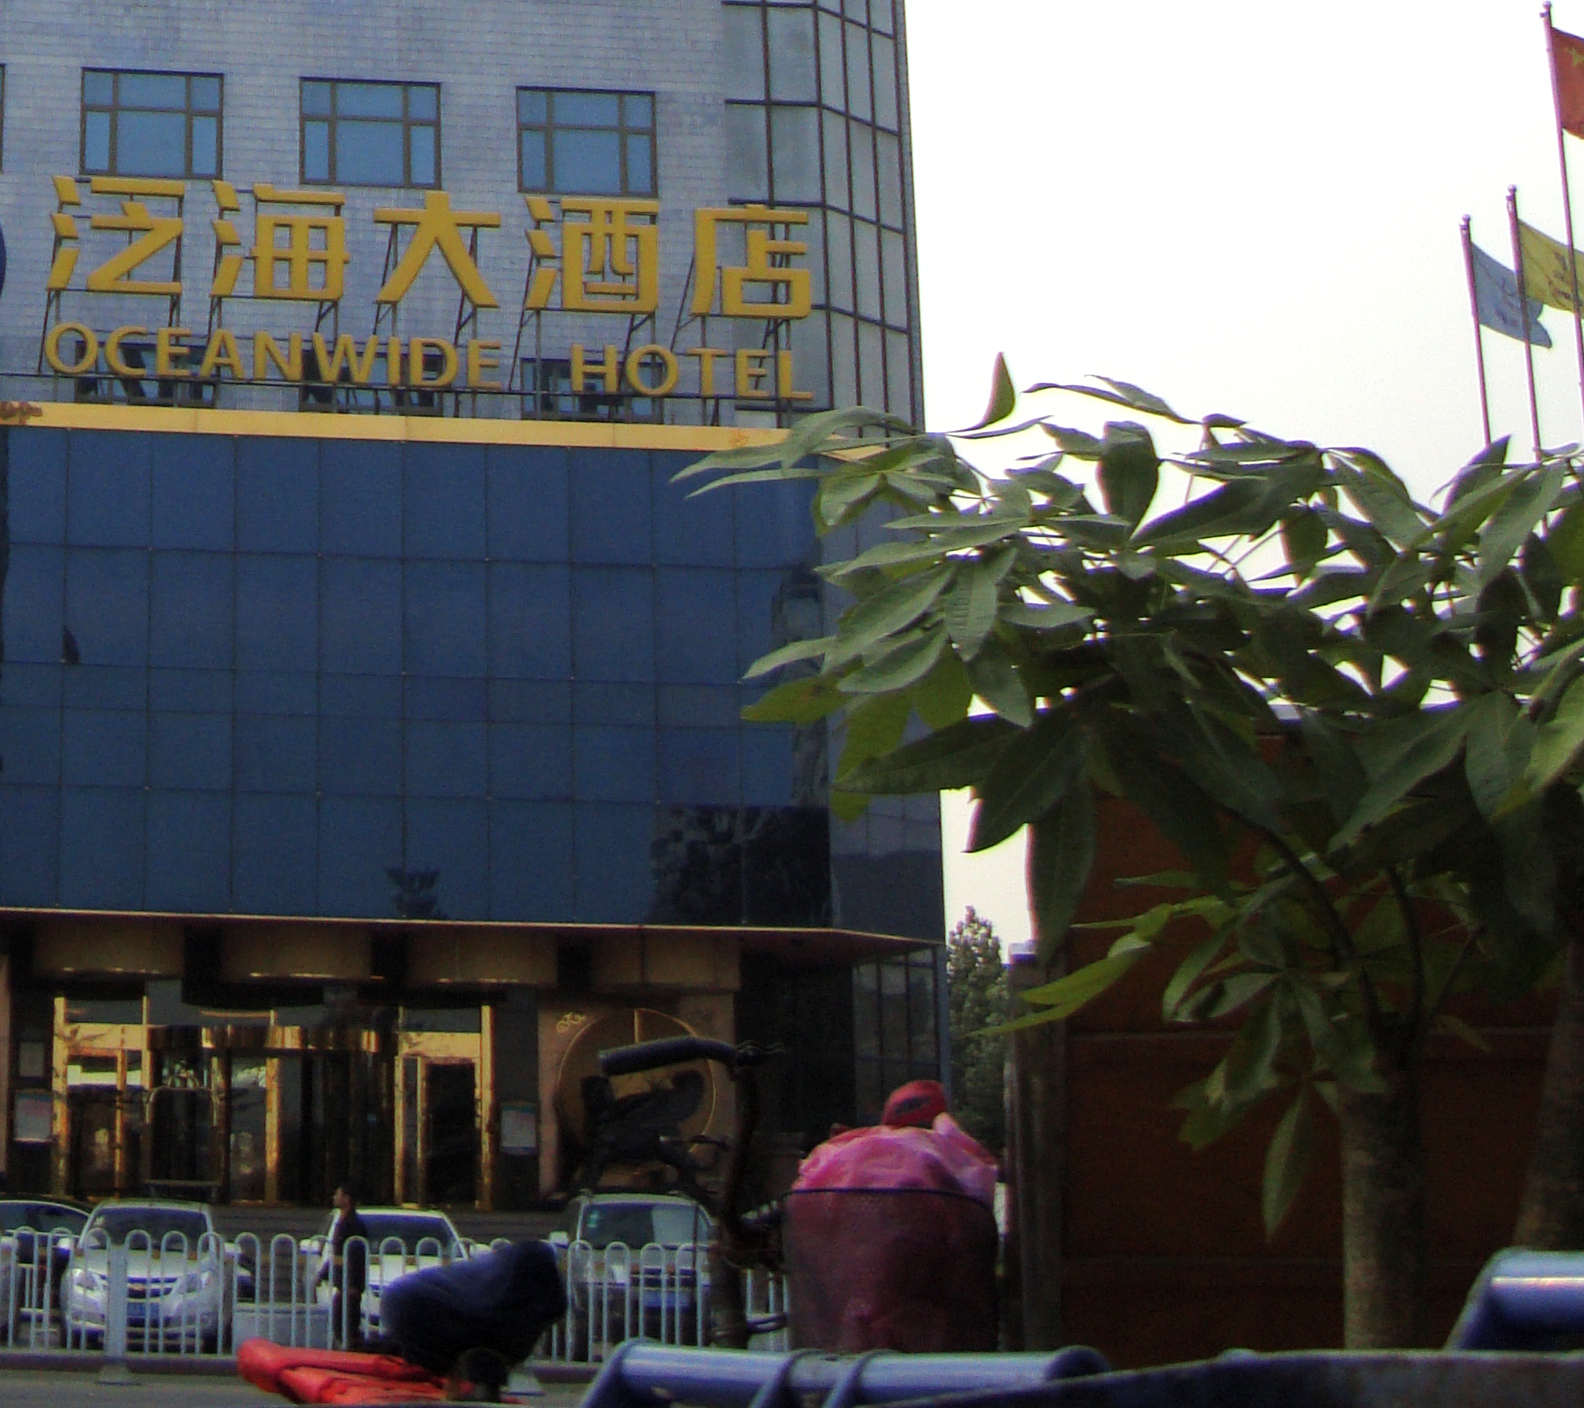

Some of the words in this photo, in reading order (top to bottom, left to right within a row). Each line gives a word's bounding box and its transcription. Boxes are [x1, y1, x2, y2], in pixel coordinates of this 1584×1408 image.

[48, 175, 812, 318] 泛海大酒店
[45, 322, 502, 390] OCEANWIDE
[571, 346, 813, 400] HOTEL
